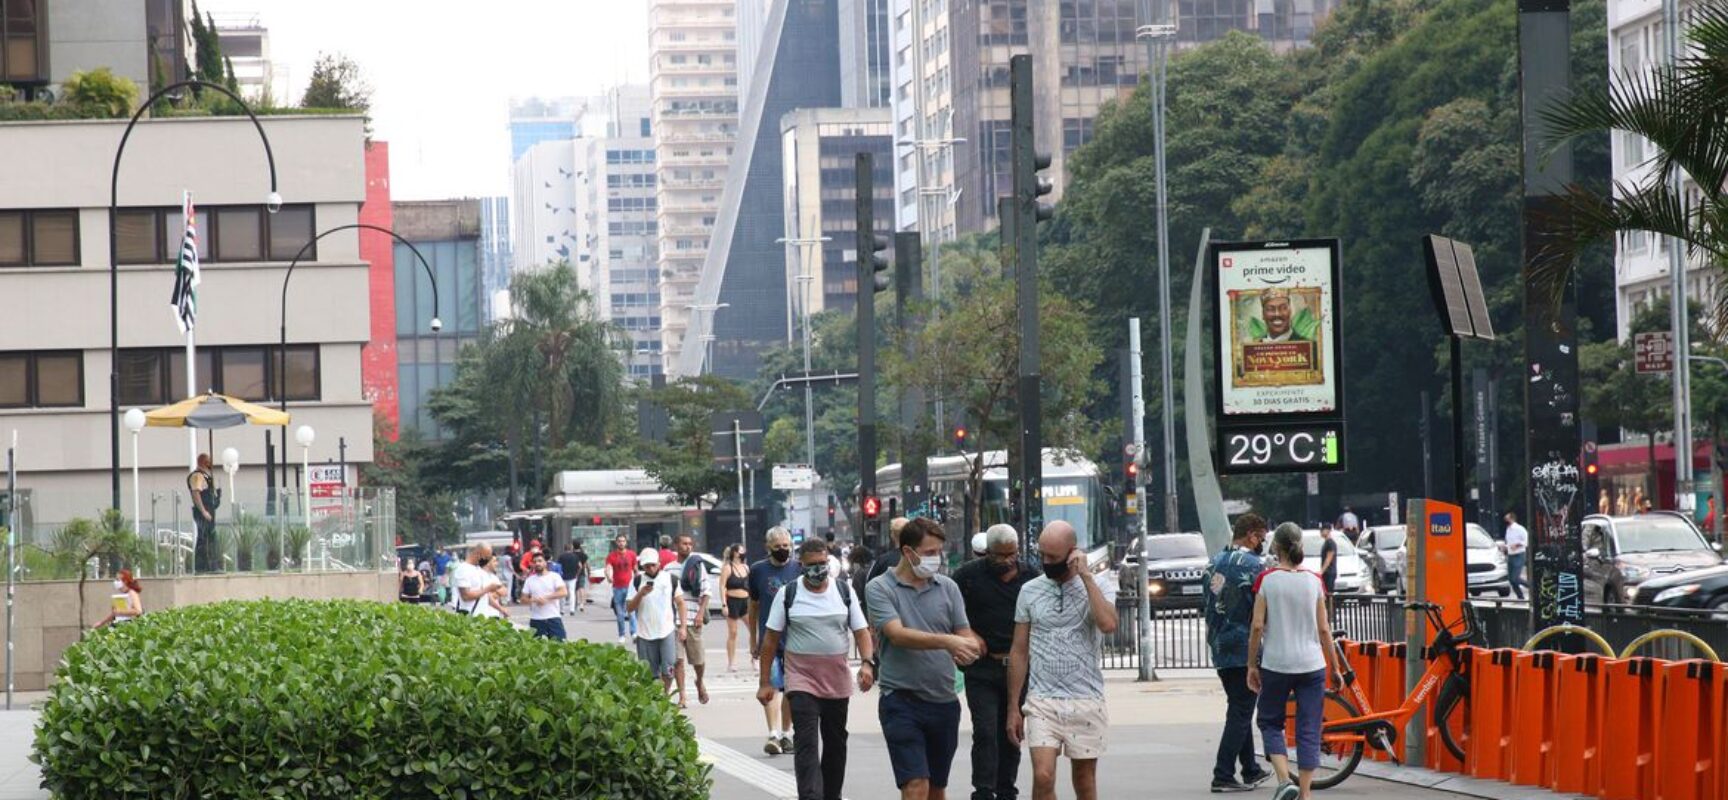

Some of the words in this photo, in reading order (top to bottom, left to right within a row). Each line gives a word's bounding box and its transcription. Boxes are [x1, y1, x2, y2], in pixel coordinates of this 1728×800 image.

[1243, 266, 1274, 277] prime
[1276, 264, 1306, 274] video
[1230, 433, 1315, 464] 29°C
[1431, 523, 1451, 533] Itaú
